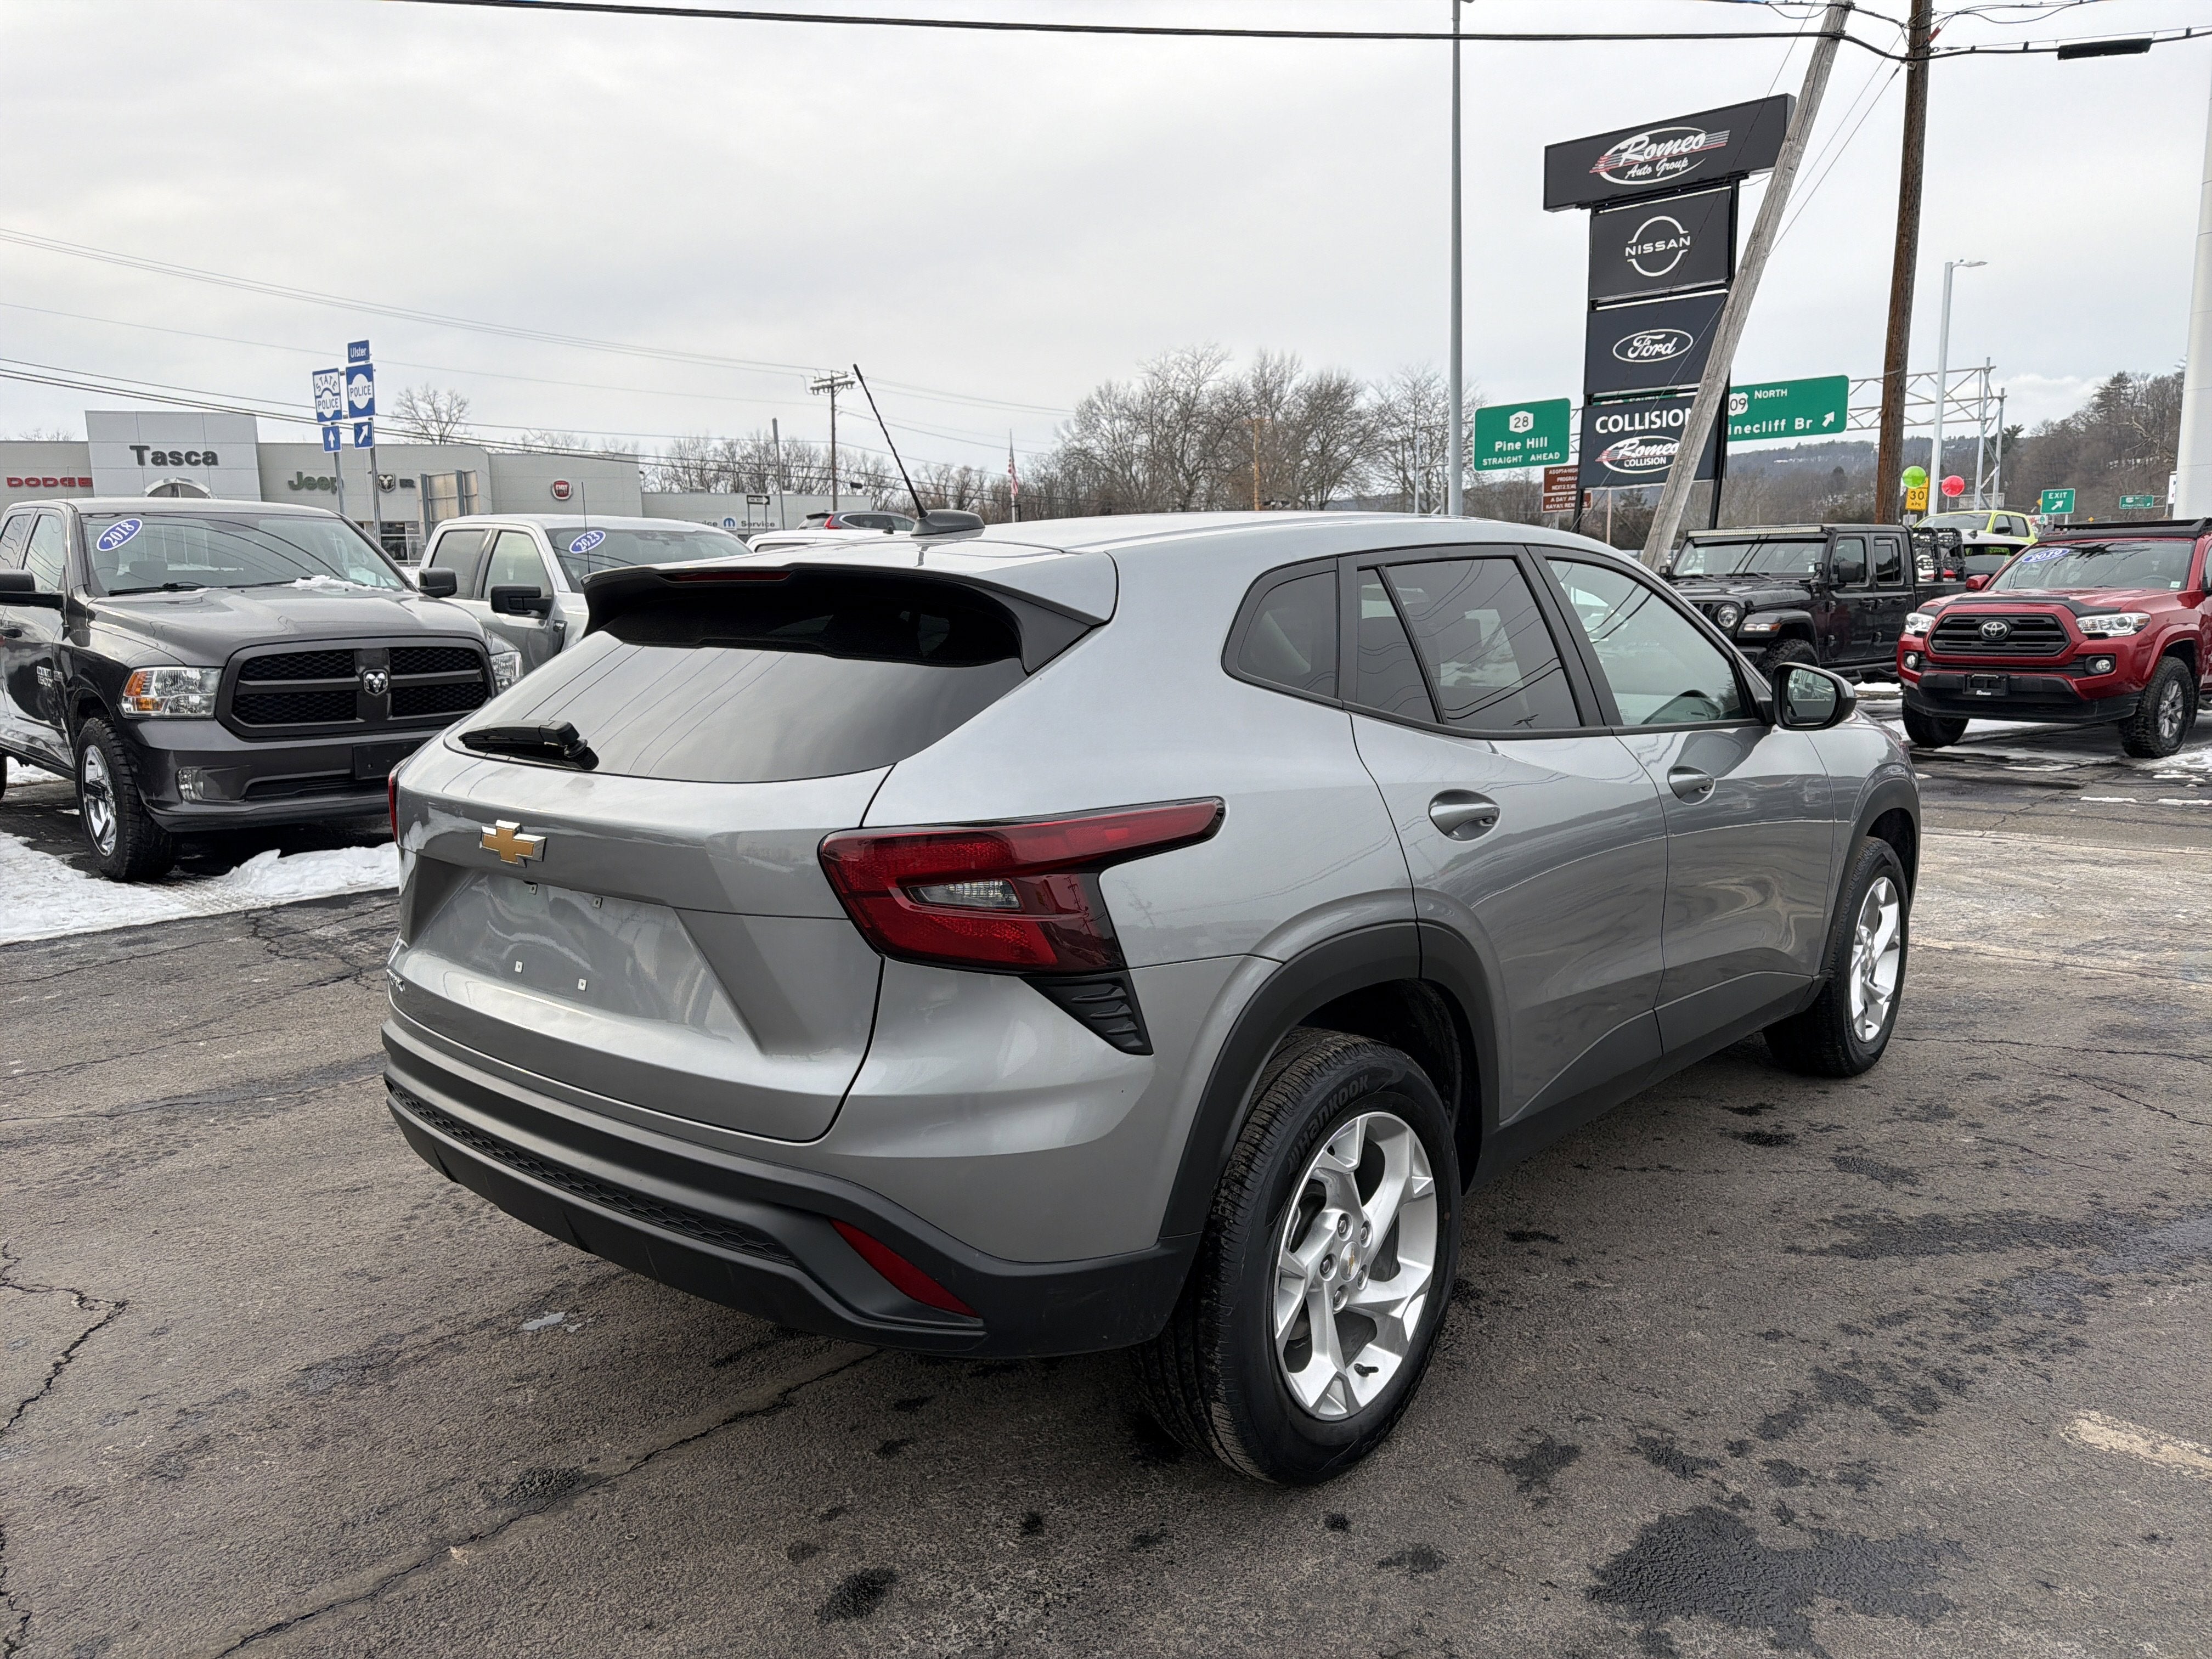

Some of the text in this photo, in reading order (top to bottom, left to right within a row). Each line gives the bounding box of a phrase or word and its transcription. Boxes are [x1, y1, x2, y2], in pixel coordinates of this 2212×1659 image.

[1618, 133, 1706, 167] Romeo
[1625, 157, 1689, 179] Auto Group
[1625, 236, 1690, 256] NISSAN
[350, 347, 367, 358] Ulster
[1627, 334, 1678, 358] Ford
[316, 375, 337, 392] STATE
[349, 385, 371, 398] POLICE
[318, 398, 339, 410] POLICE
[1729, 388, 1788, 411] 09 NORTH
[1513, 416, 1529, 428] 28
[1728, 417, 1813, 436] inecliff Br
[1495, 436, 1548, 452] Pine Hill
[1617, 439, 1680, 459] Romeo
[129, 445, 218, 466] Tasca
[1482, 452, 1560, 466] STRAIGHT AHEAD
[1623, 456, 1667, 467] COLLISION
[7, 477, 93, 487] DODGE
[288, 471, 344, 494] Jeep
[1910, 490, 1925, 500] 30
[104, 522, 135, 546] 2018
[576, 532, 600, 550] 2023
[2030, 549, 2063, 562] 2019
